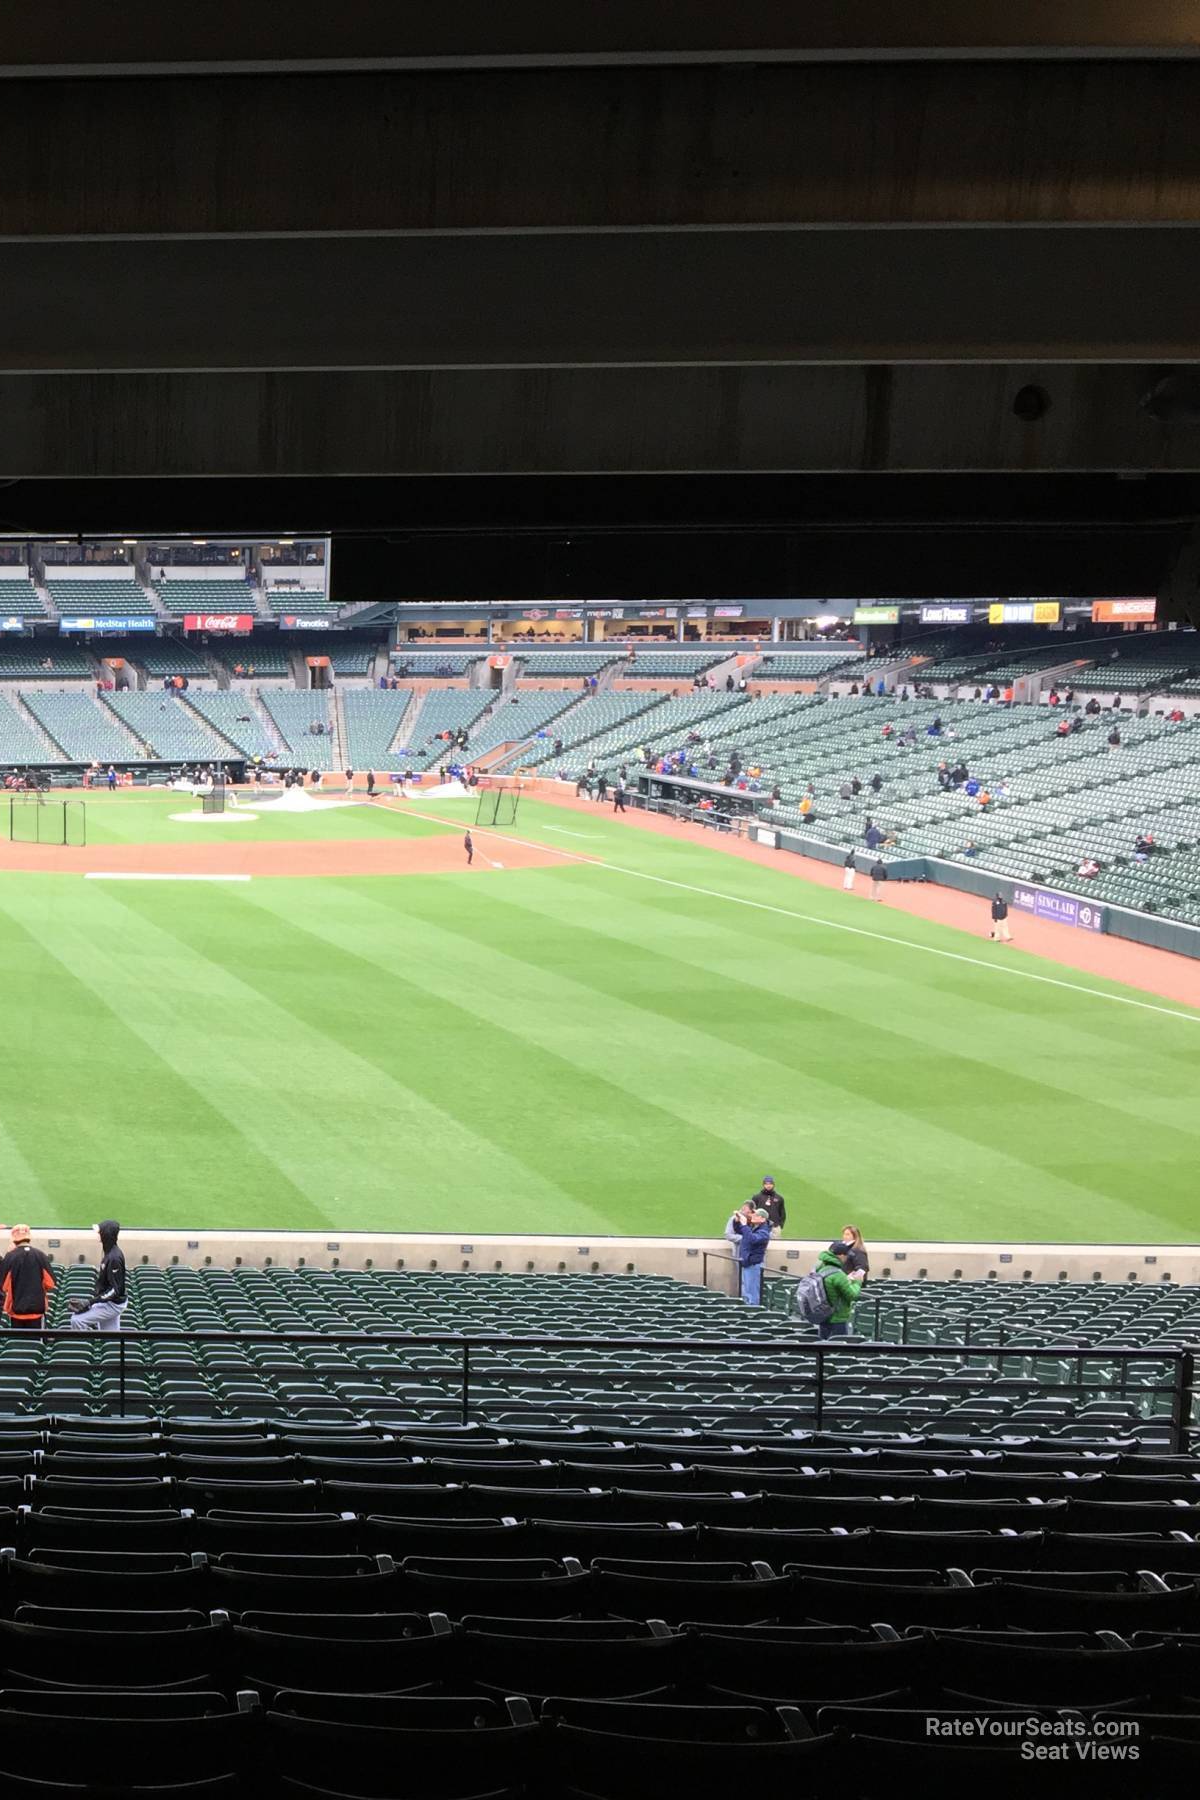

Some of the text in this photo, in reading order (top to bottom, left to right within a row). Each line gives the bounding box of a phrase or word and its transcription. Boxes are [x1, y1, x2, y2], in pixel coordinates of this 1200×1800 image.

[95, 619, 127, 628] MedStar
[128, 619, 154, 628] Health
[295, 618, 329, 628] Fanatics
[1038, 894, 1076, 915] SINCLAIR
